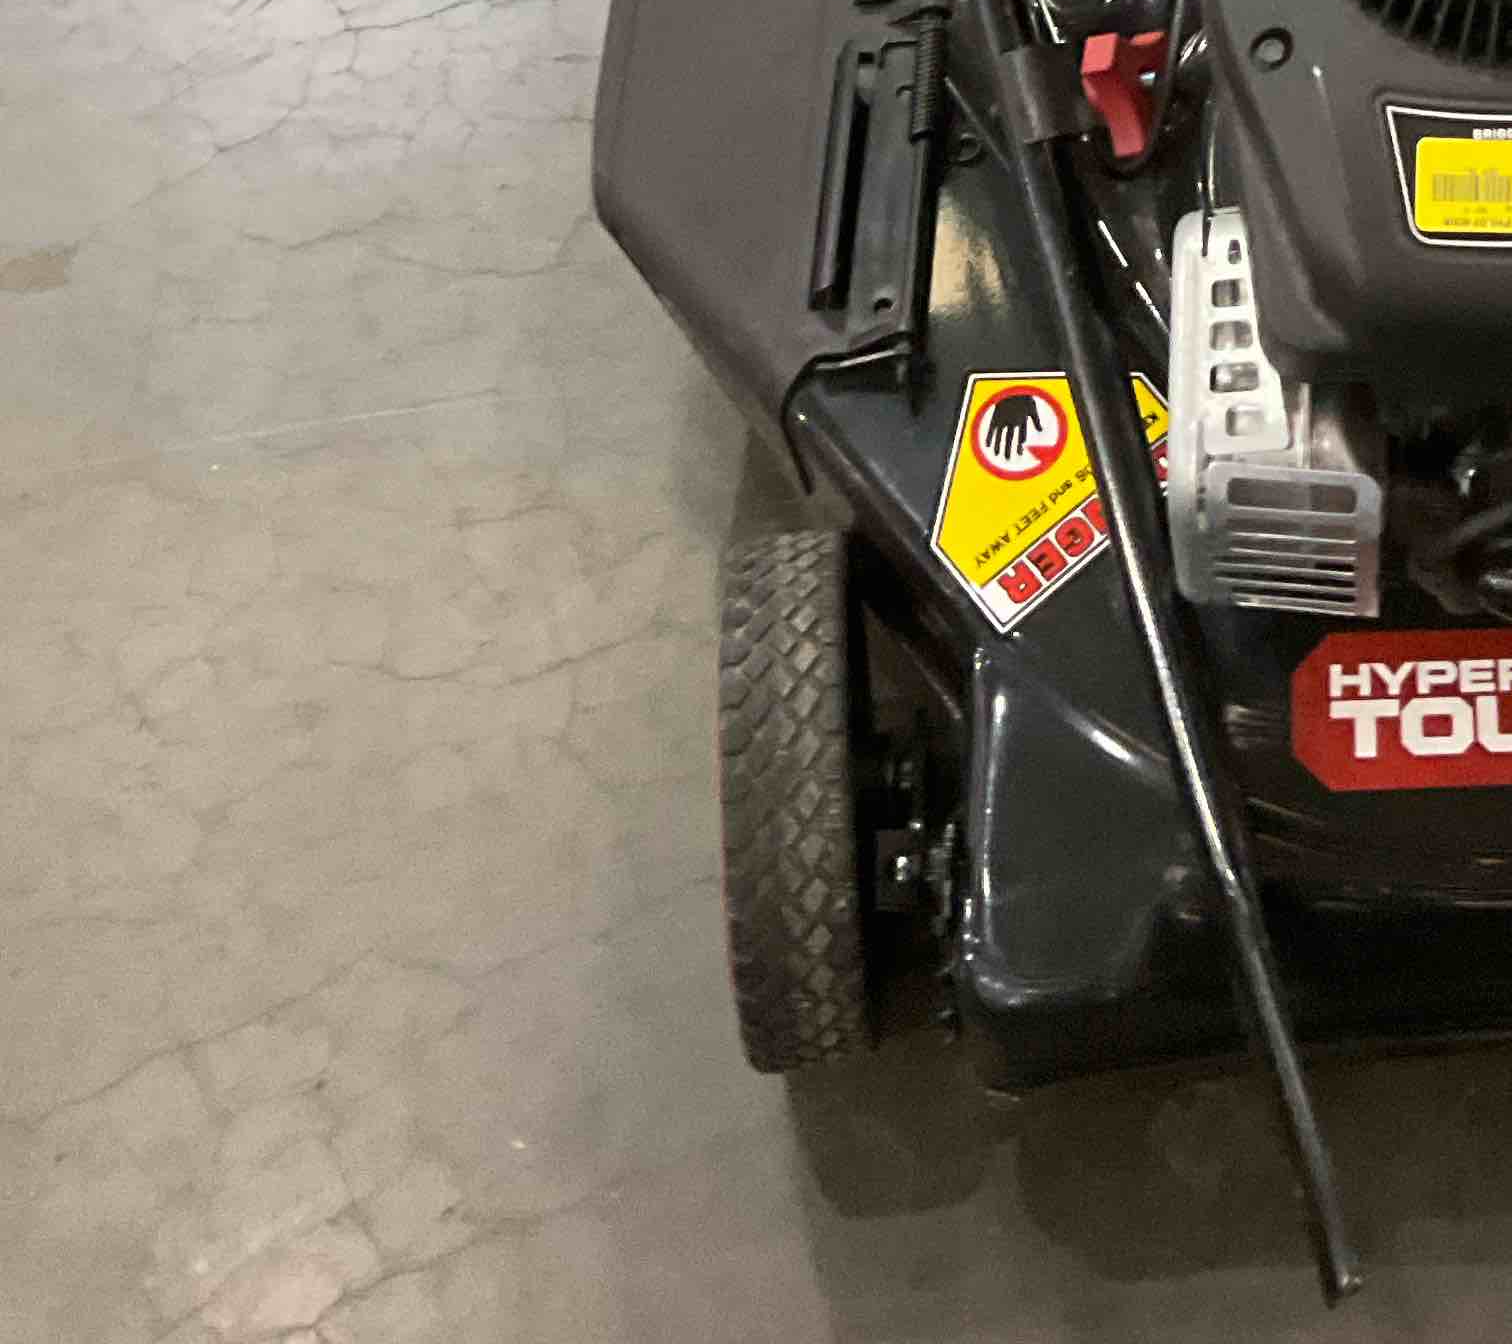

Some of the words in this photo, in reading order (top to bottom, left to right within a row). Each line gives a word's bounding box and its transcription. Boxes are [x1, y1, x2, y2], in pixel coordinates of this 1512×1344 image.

[1050, 481, 1073, 504] and
[1016, 502, 1049, 533] FEET
[974, 534, 1011, 568] AWAY
